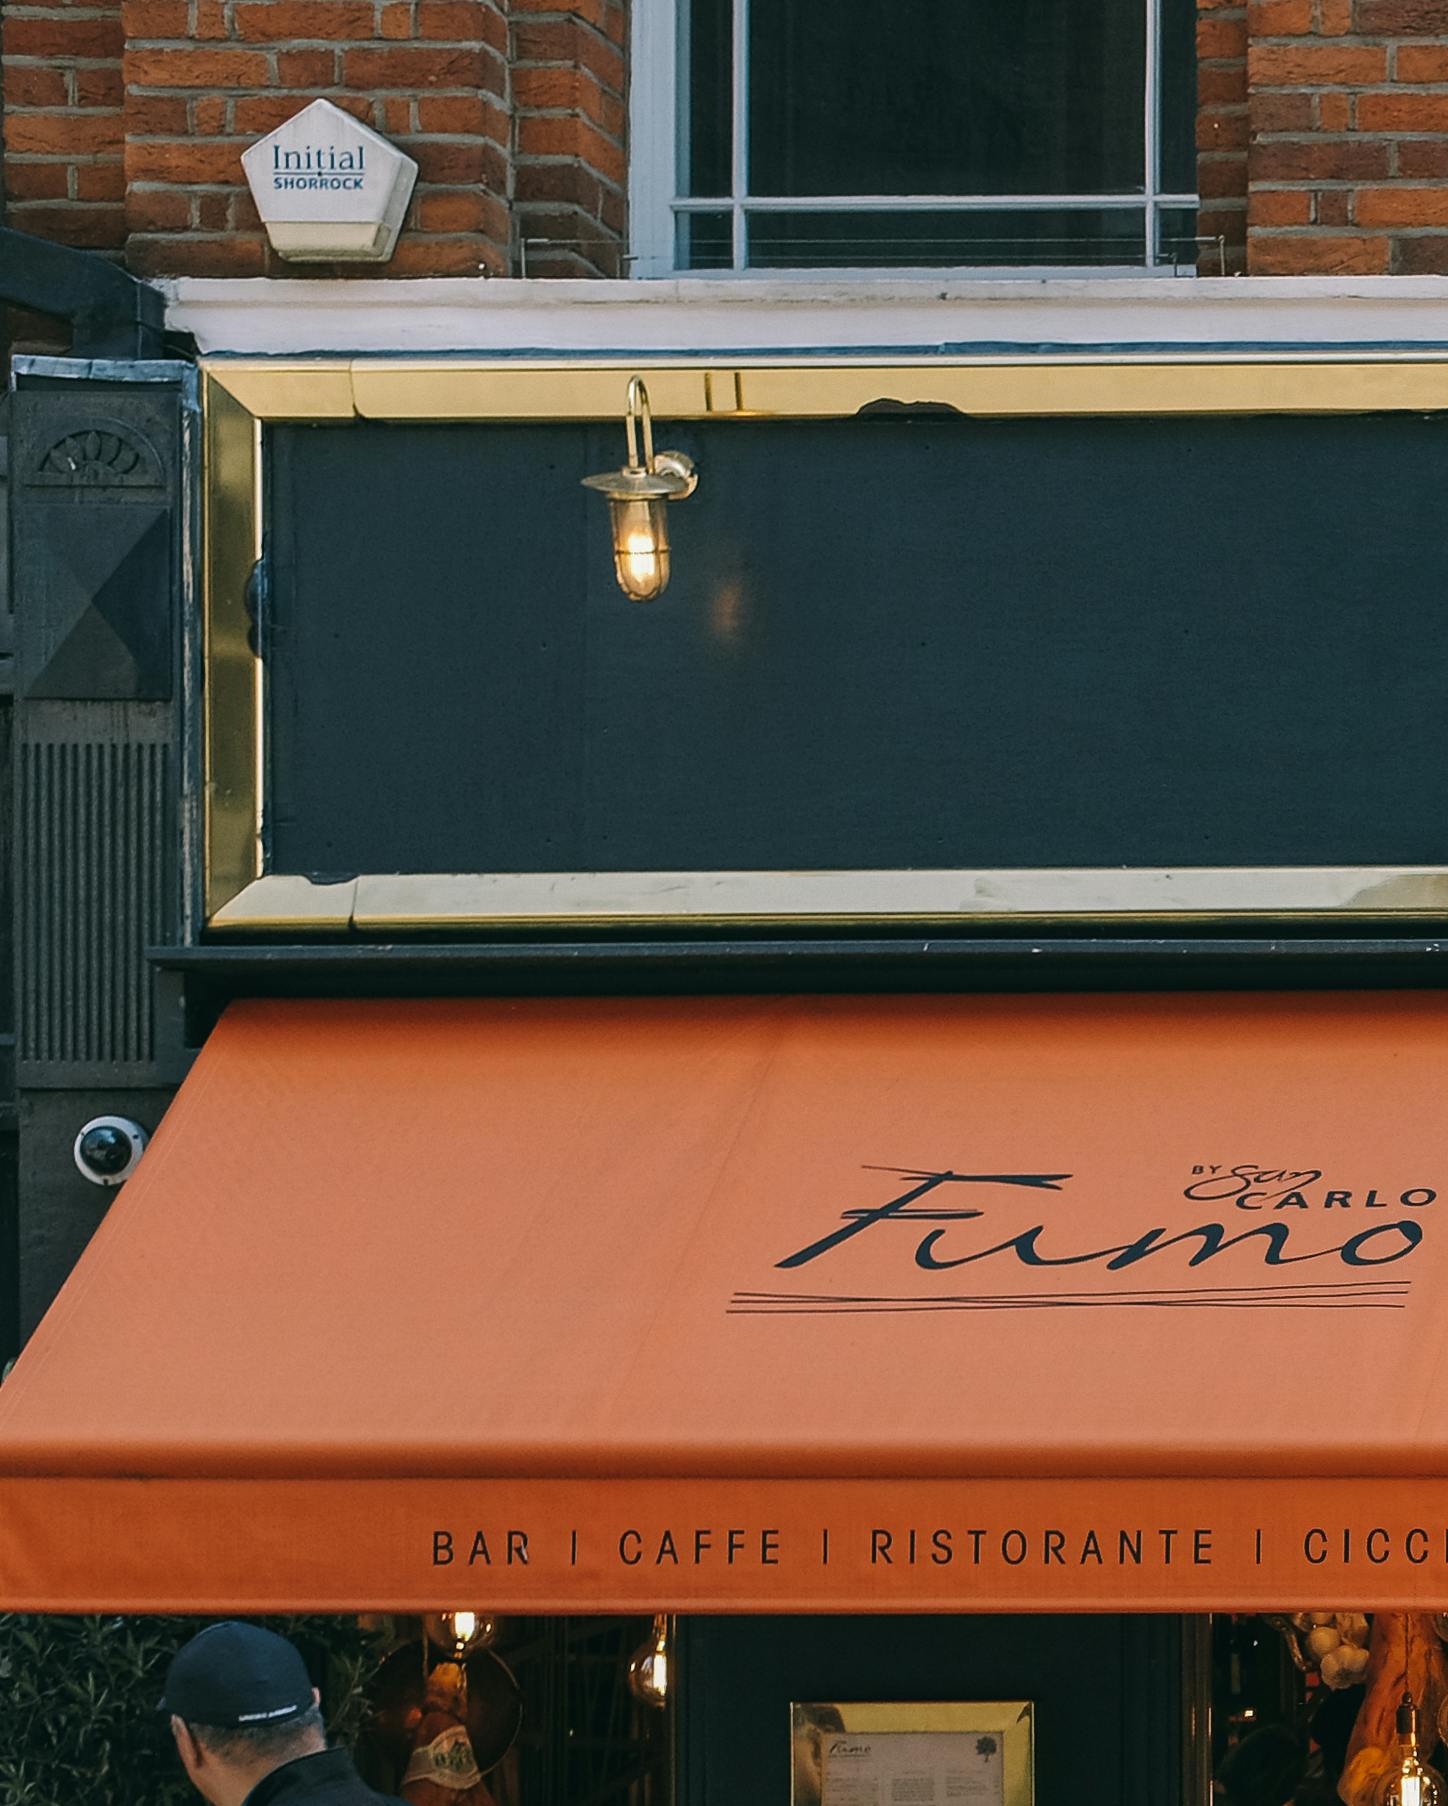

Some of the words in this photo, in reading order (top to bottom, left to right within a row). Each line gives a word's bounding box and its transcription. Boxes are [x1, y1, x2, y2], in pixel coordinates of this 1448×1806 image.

[273, 145, 365, 170] Initial
[273, 177, 364, 190] SHORROCK
[1191, 1165, 1222, 1176] BY
[1184, 1164, 1324, 1203] San
[1235, 1186, 1438, 1211] CARLO
[774, 1165, 1425, 1271] Fumo
[433, 1530, 529, 1566] BAR
[619, 1529, 780, 1566] CAFFE
[870, 1529, 1213, 1566] RISTORANTE
